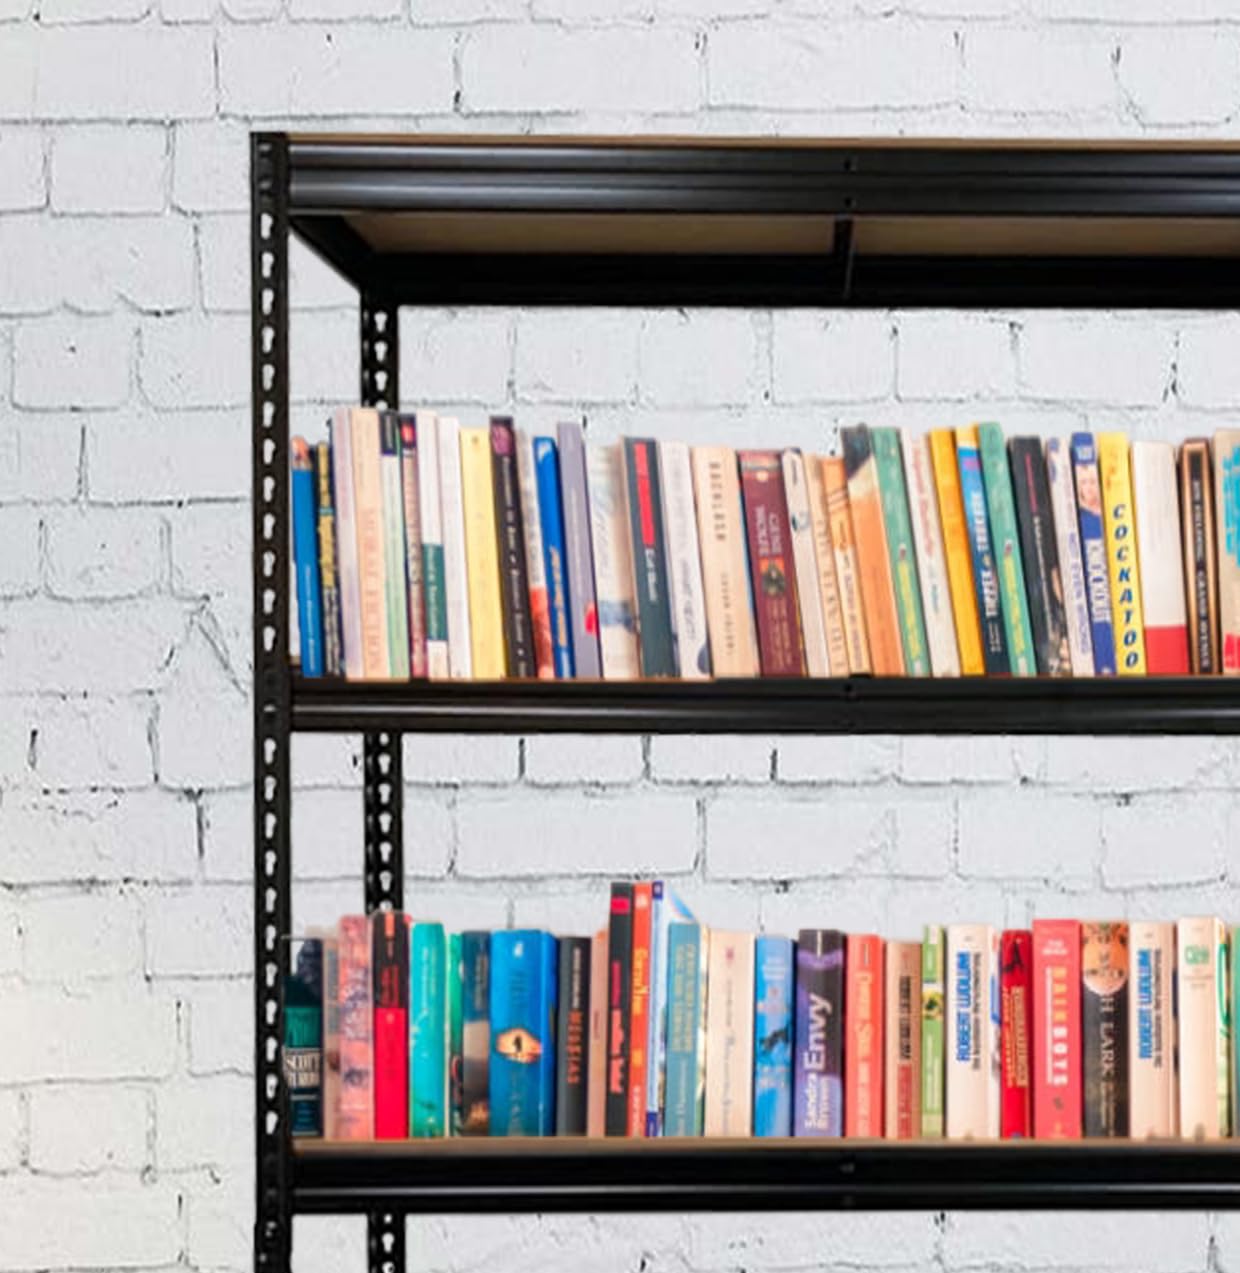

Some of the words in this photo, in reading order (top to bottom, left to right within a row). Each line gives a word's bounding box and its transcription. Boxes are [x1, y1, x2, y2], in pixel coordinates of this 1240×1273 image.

[1112, 503, 1139, 668] COCKATOO
[956, 951, 971, 1008] LUDLUM
[803, 991, 832, 1071] Envy
[956, 1011, 971, 1062] ROBERT
[1101, 1022, 1115, 1079] LARK
[804, 1072, 818, 1129] Sandra
